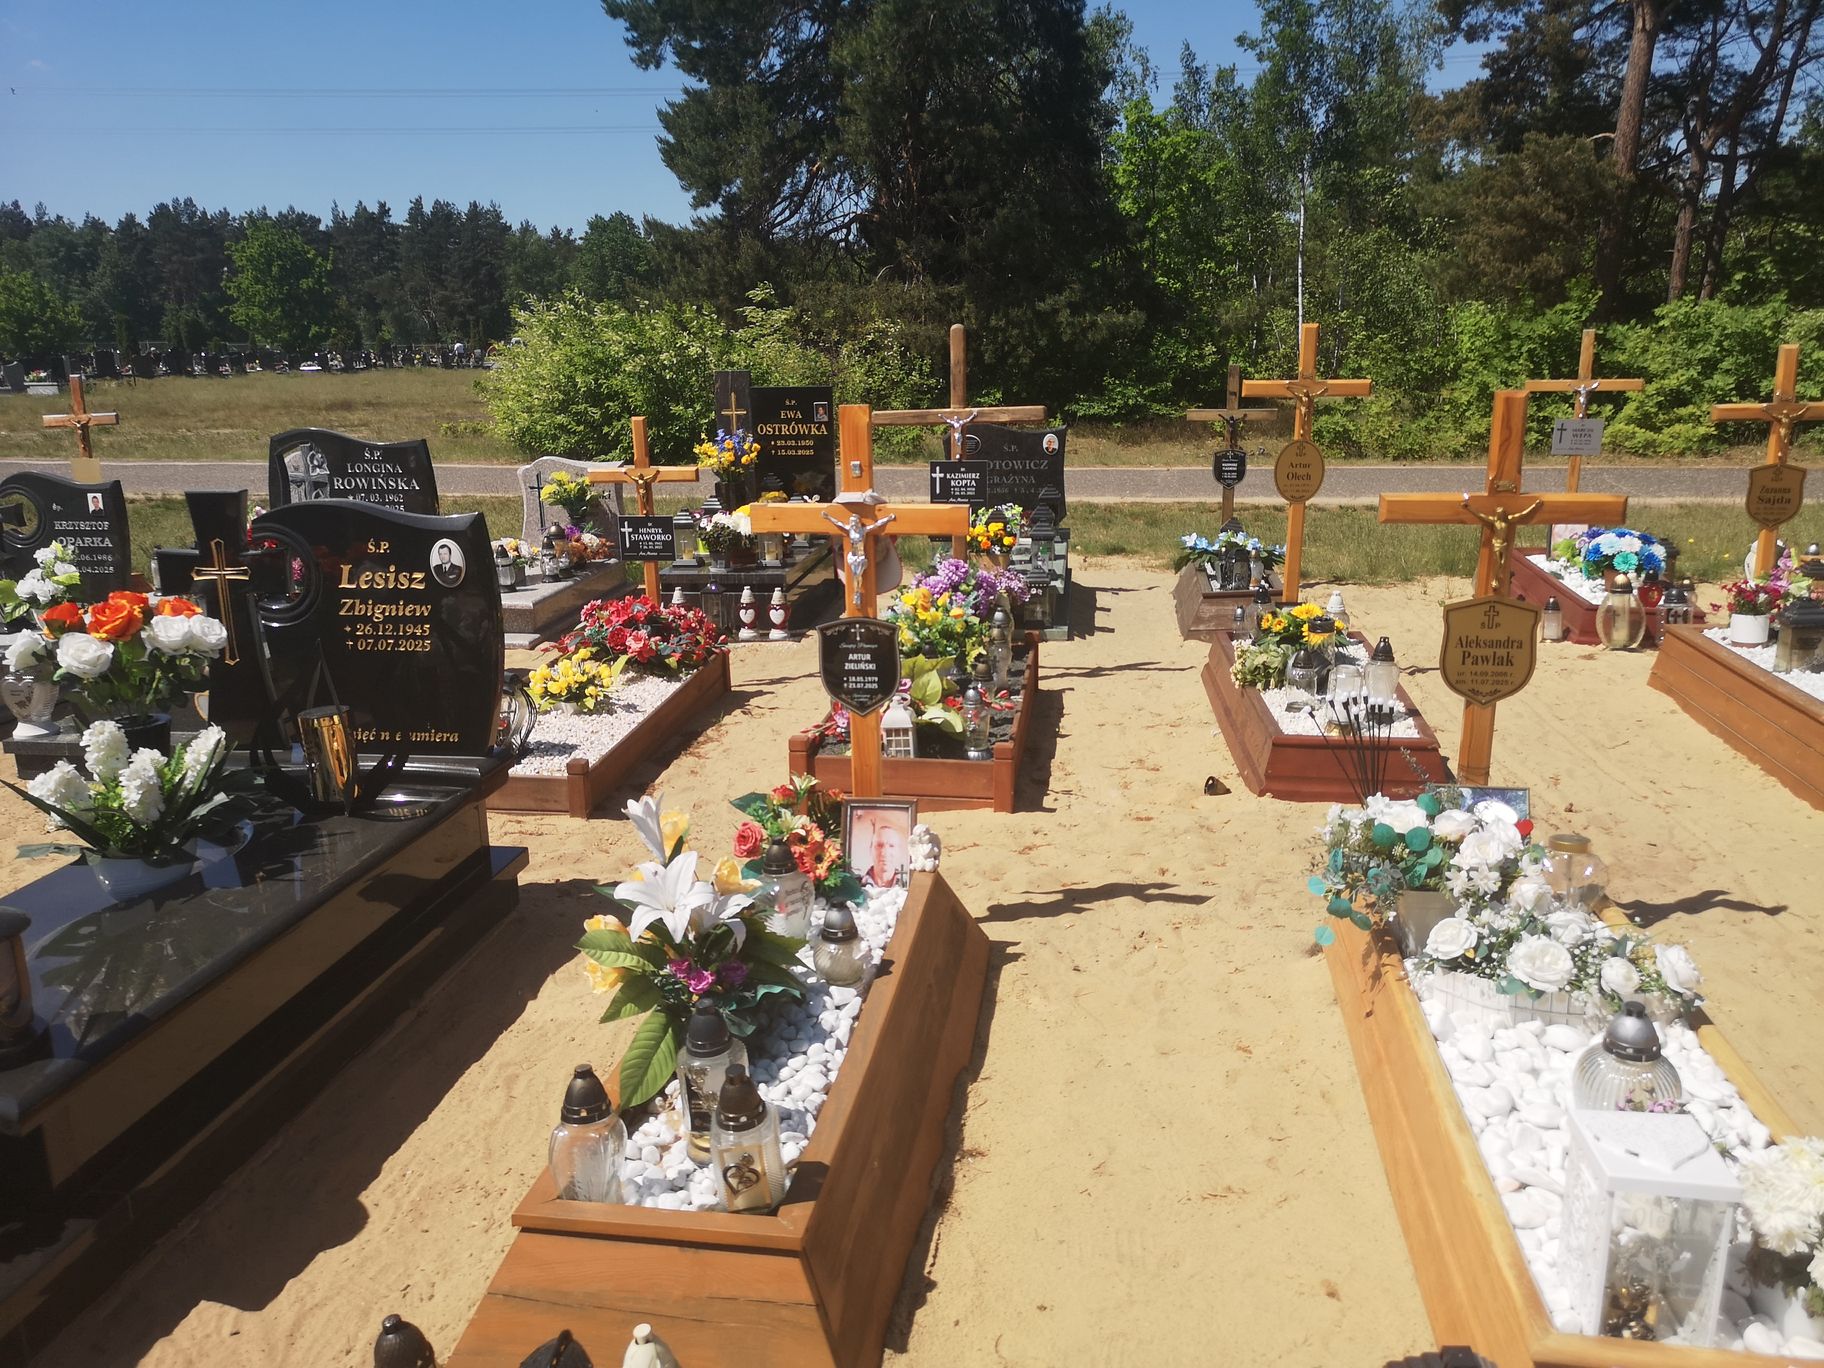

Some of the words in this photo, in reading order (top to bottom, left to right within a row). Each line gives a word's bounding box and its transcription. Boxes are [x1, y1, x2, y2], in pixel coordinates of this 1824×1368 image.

[780, 410, 803, 419] EWA
[757, 421, 829, 435] OSTRÓWKA
[346, 462, 403, 474] LONGINA
[987, 460, 1049, 470] OTOWICZ
[333, 474, 420, 490] ROWIŃSKA
[1286, 471, 1312, 481] Olech
[950, 479, 977, 487] KOPTA
[54, 520, 110, 530] KRZYSZTOF
[630, 533, 672, 541] STAWORKO
[367, 538, 390, 553] Ś.P.
[338, 564, 426, 590] Lesisz
[338, 599, 432, 622] Zbigniew
[355, 623, 431, 636] 26.12.1945
[357, 639, 432, 652] 07.07.2025
[1455, 635, 1523, 649] Aleksandra
[848, 653, 872, 661] ARTUR
[1461, 650, 1515, 667] Pawlak
[844, 661, 877, 670] ZIELIŃSKI
[409, 729, 460, 742] umiera
